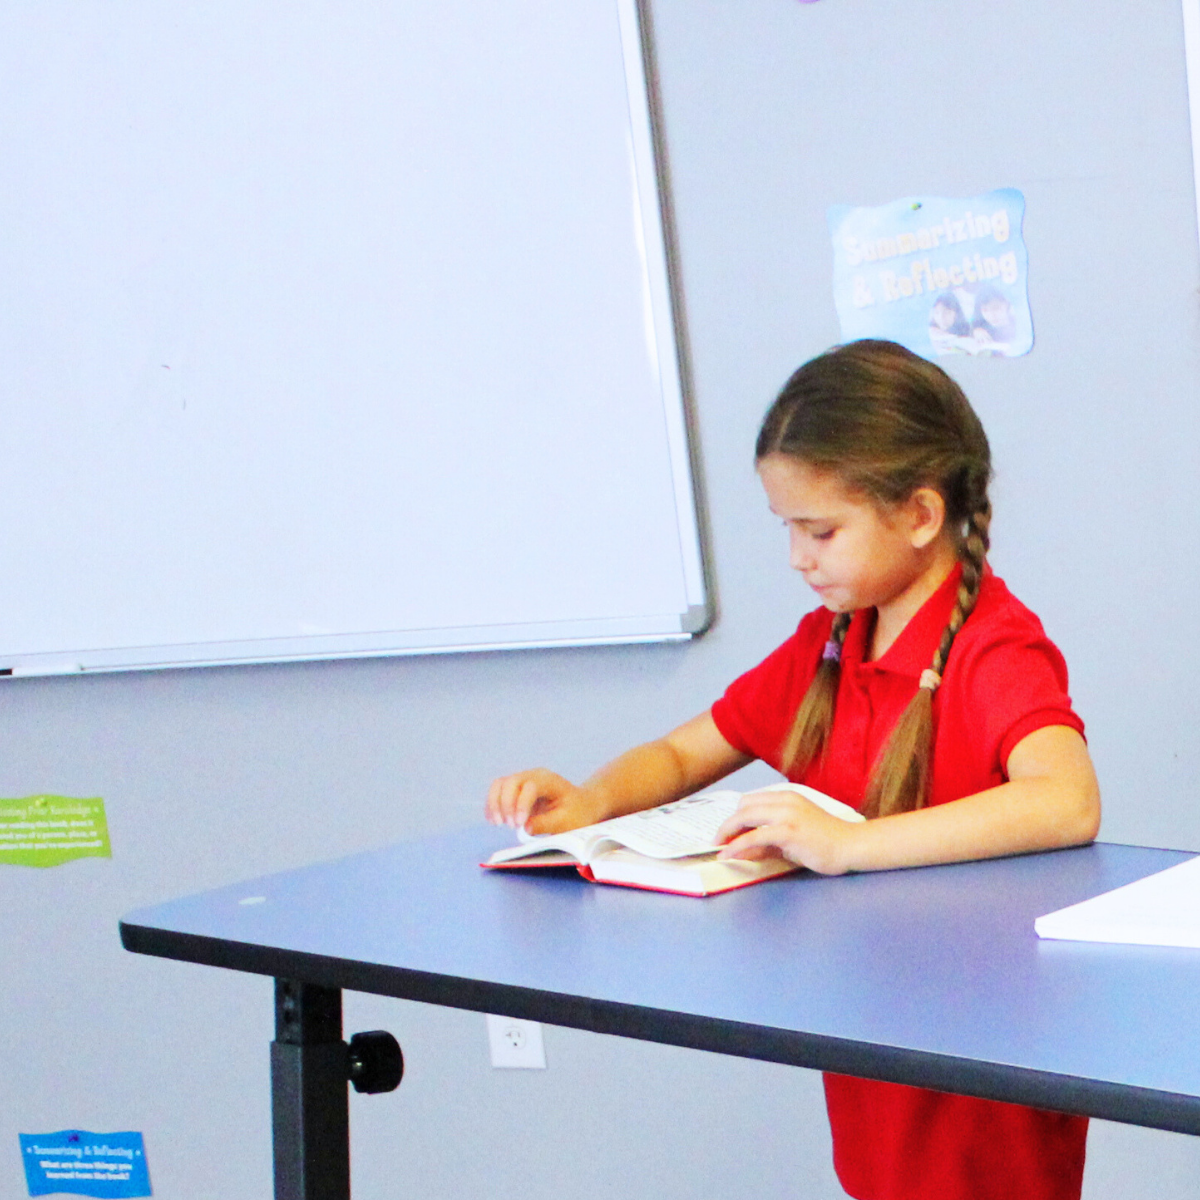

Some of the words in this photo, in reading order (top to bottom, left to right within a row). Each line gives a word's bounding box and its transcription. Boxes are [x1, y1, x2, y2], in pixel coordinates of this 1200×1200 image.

[843, 209, 1009, 266] Summarizing
[853, 275, 875, 308] &
[880, 251, 1018, 301] Reflecting
